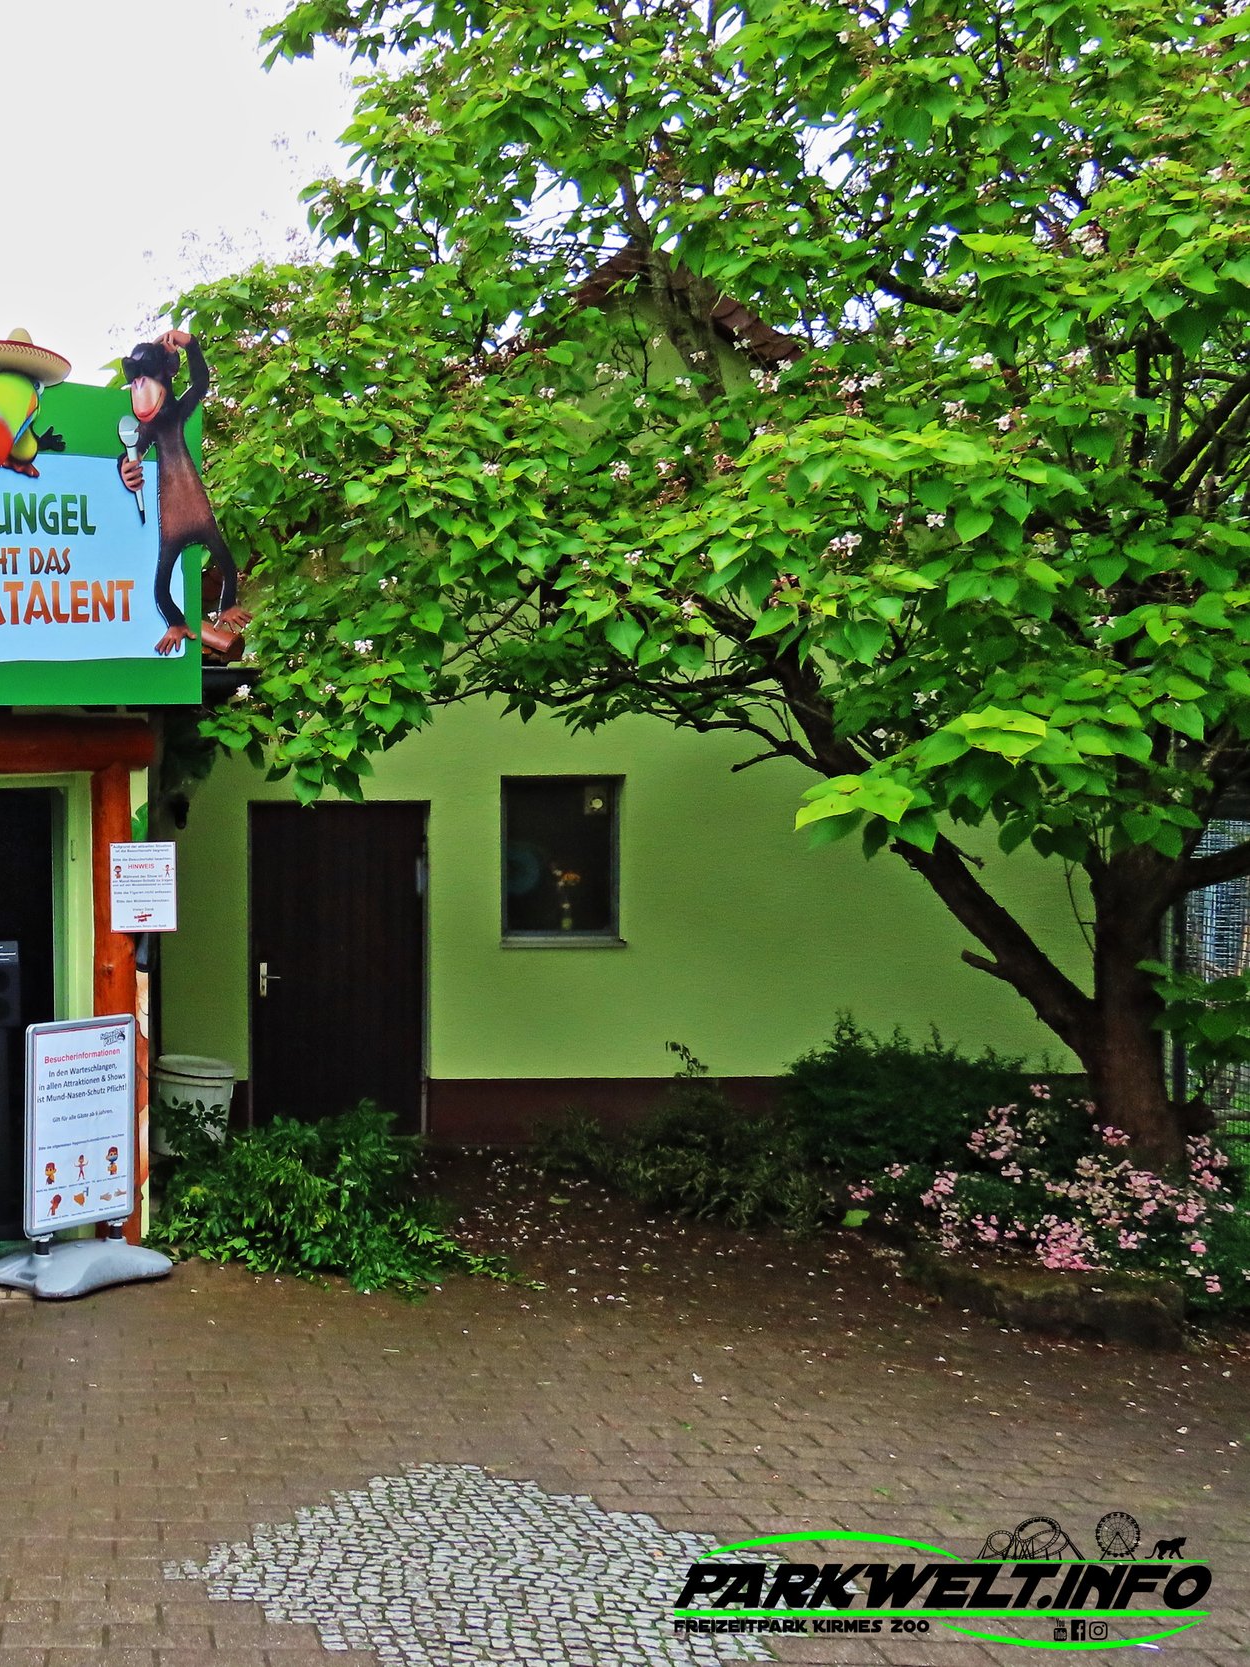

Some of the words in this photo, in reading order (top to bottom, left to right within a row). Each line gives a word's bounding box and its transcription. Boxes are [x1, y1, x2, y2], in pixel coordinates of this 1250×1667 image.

[29, 547, 71, 575] DAS
[44, 1047, 121, 1064] Besucherinformationen
[49, 1070, 56, 1078] In
[57, 1069, 68, 1077] den
[69, 1063, 118, 1075] Warteschlangen,
[38, 1083, 45, 1091] in
[46, 1081, 62, 1090] allen
[63, 1076, 100, 1088] Attraktionen
[107, 1072, 126, 1081] Shows
[46, 1087, 106, 1102] Mund-Nasen-Schutz
[106, 1083, 127, 1093] Pflicht!
